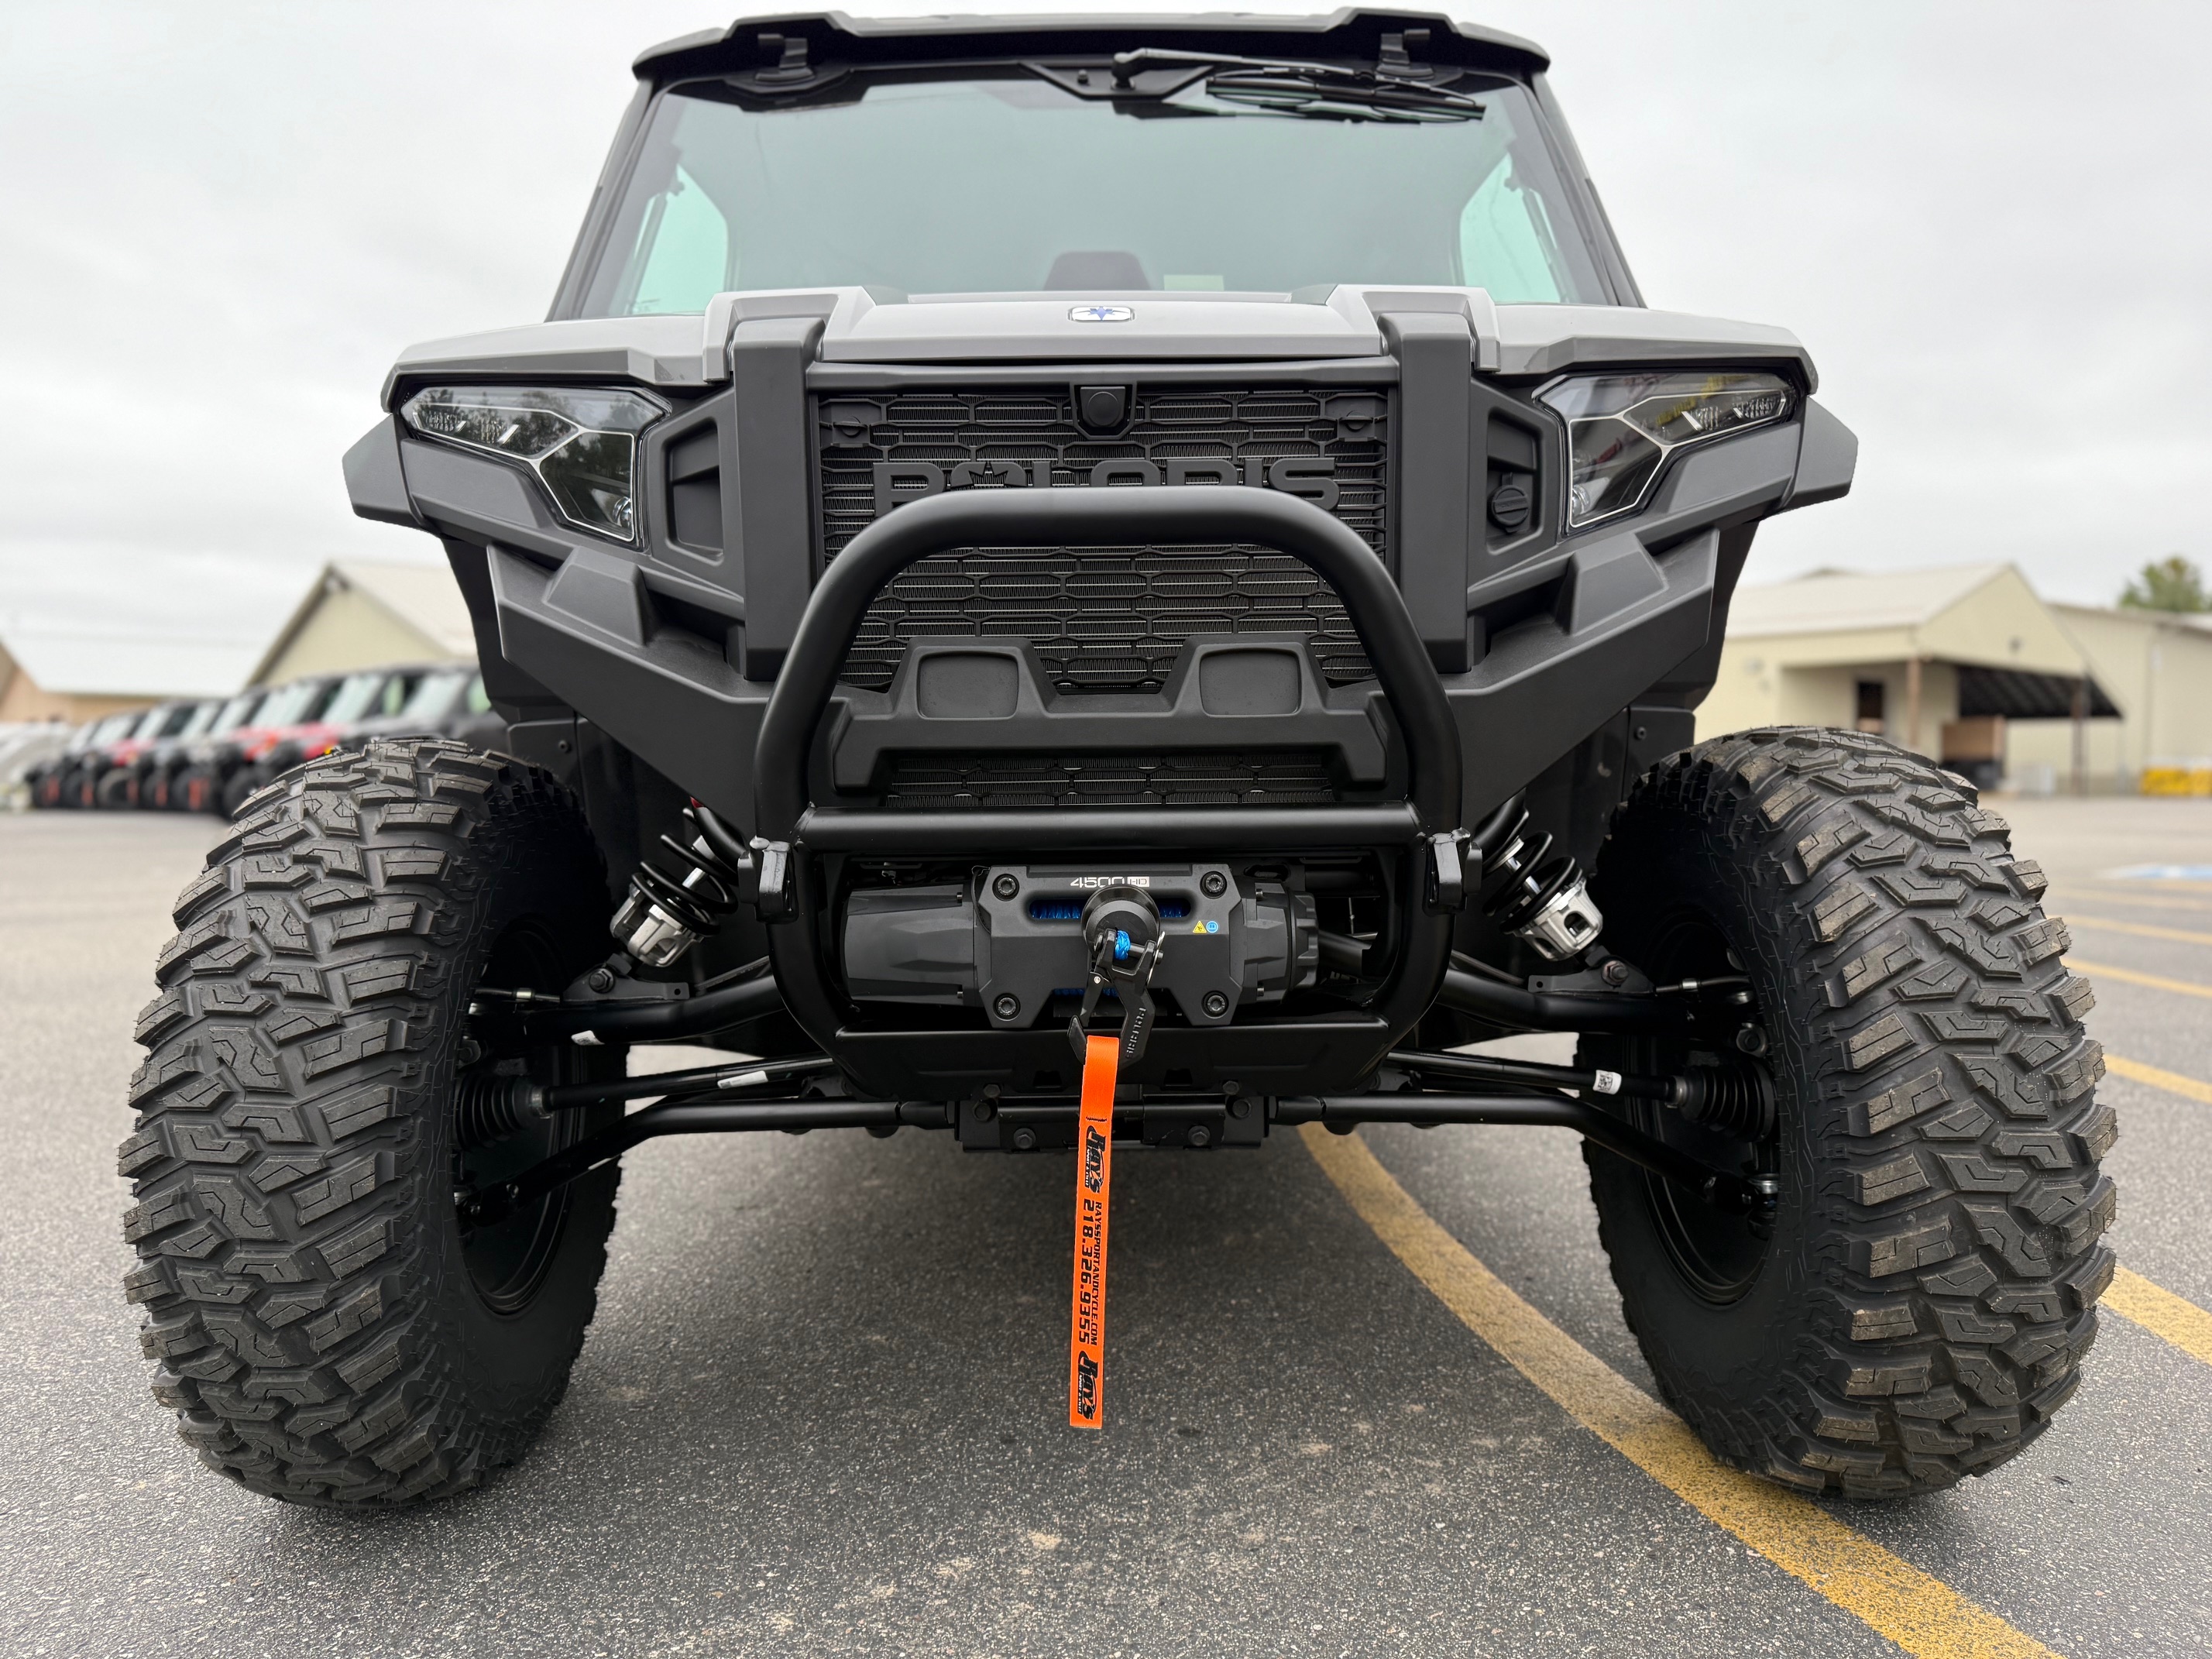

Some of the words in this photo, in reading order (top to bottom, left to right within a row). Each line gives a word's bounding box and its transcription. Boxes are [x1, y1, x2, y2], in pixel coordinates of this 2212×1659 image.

[1070, 876, 1125, 888] 4500
[1079, 1199, 1094, 1345] 218.326.9355
[1091, 1201, 1102, 1346] RAYSSPORTANDCYCLE.COM
